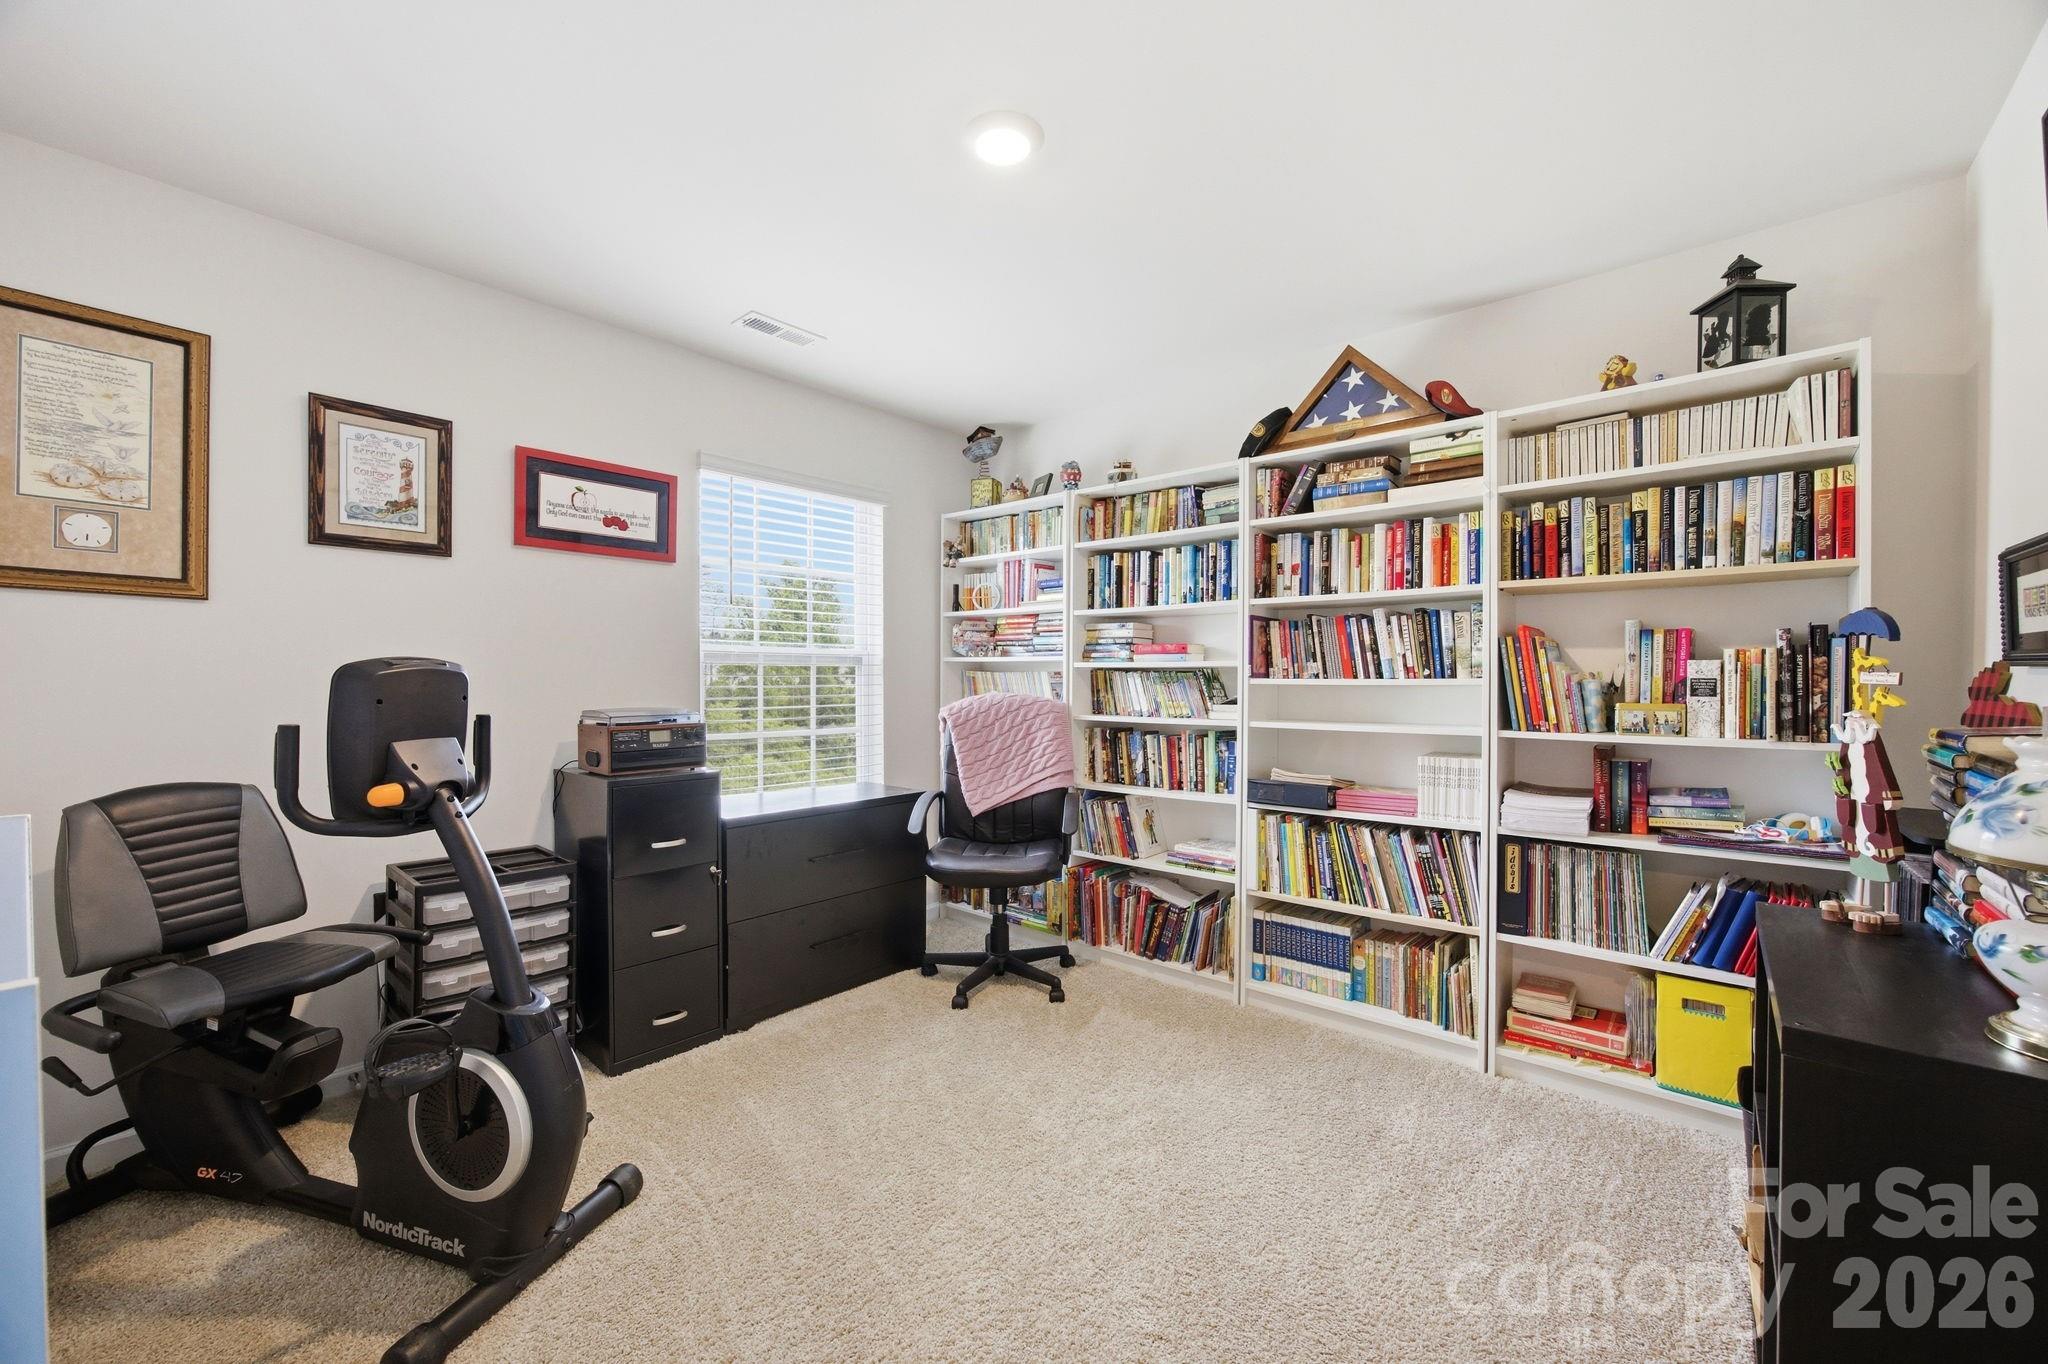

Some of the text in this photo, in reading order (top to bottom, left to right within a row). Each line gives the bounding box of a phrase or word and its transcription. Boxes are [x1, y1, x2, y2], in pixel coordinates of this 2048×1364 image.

[354, 466, 395, 481] Courage
[197, 1167, 243, 1183] GX 47
[363, 1210, 465, 1258] NordicTrack
